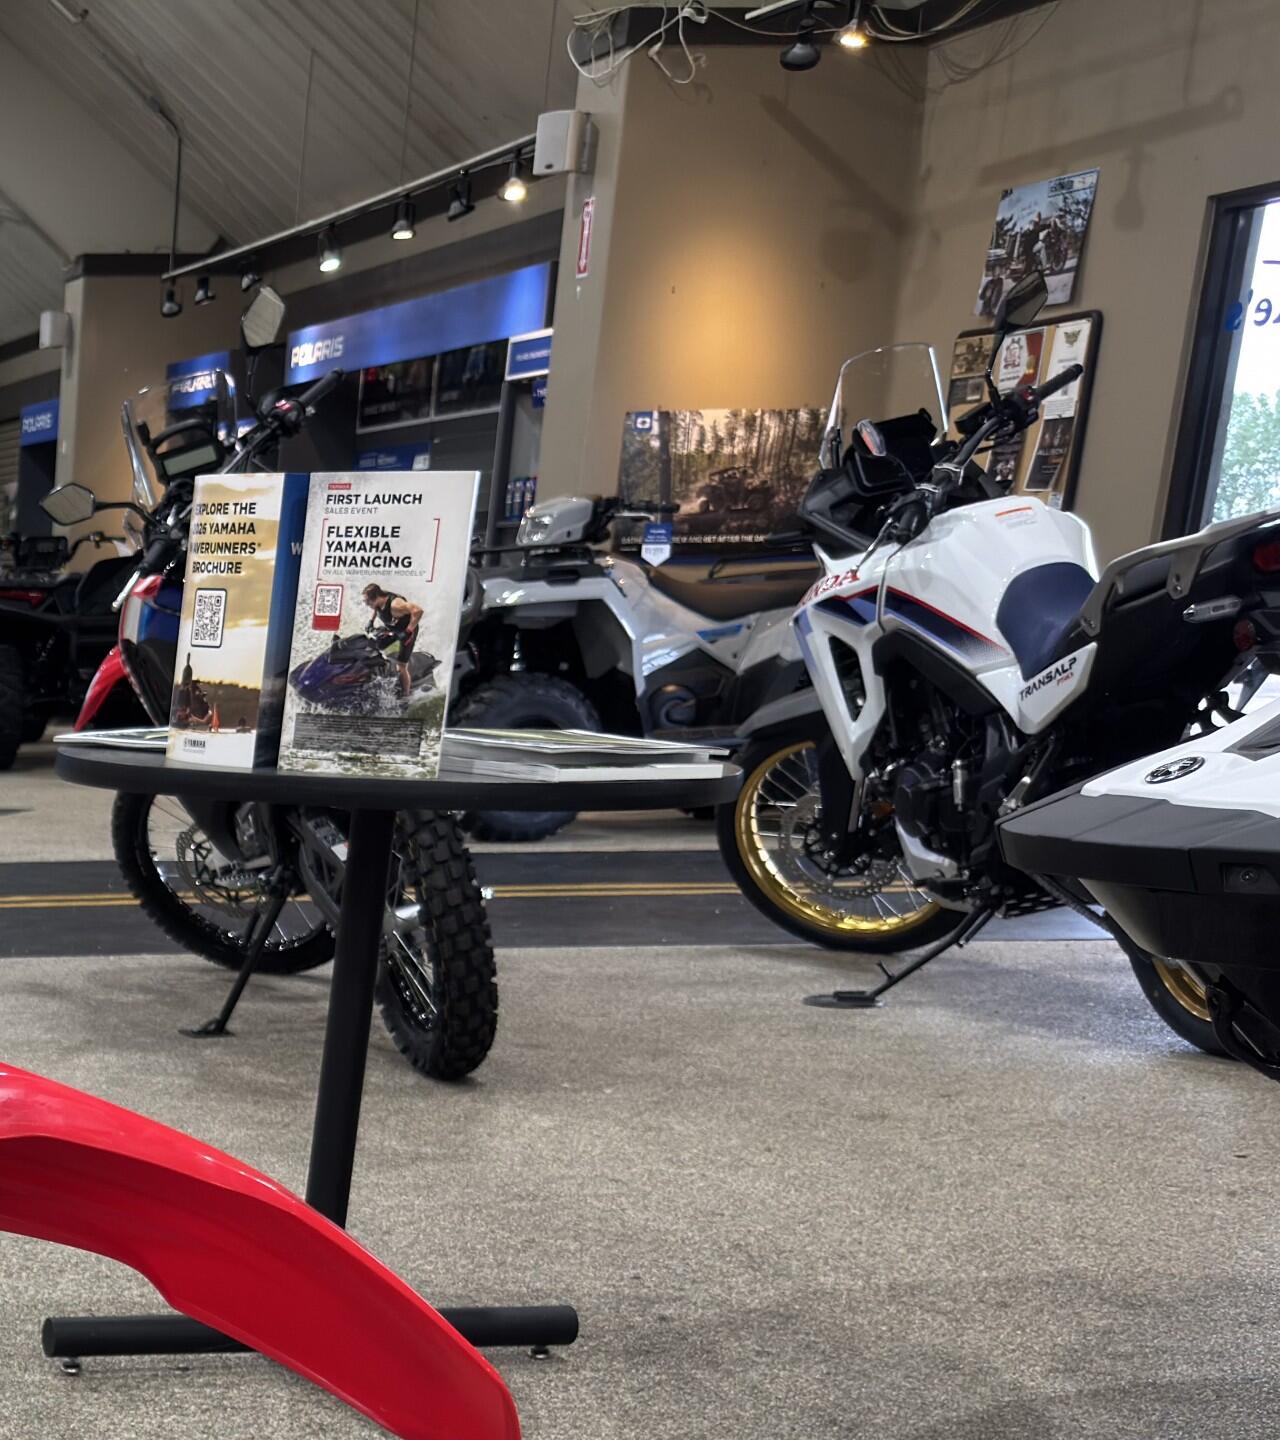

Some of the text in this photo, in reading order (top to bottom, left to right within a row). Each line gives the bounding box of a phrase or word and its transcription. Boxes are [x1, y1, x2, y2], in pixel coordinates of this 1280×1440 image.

[290, 336, 344, 369] POLARIS
[172, 371, 216, 393] POLARI
[21, 413, 53, 433] POLARIS
[326, 493, 423, 505] FIRST LAUNCH
[195, 502, 256, 516] EXPLORE THE
[324, 507, 378, 515] SALES EVENT
[209, 522, 256, 535] YAMAHA
[327, 526, 401, 538] FLEXIBLE
[326, 541, 392, 553] YAMAHA
[192, 561, 242, 575] BROCHURE
[324, 556, 412, 568] FINANCING
[1019, 656, 1077, 701] TRANSALP
